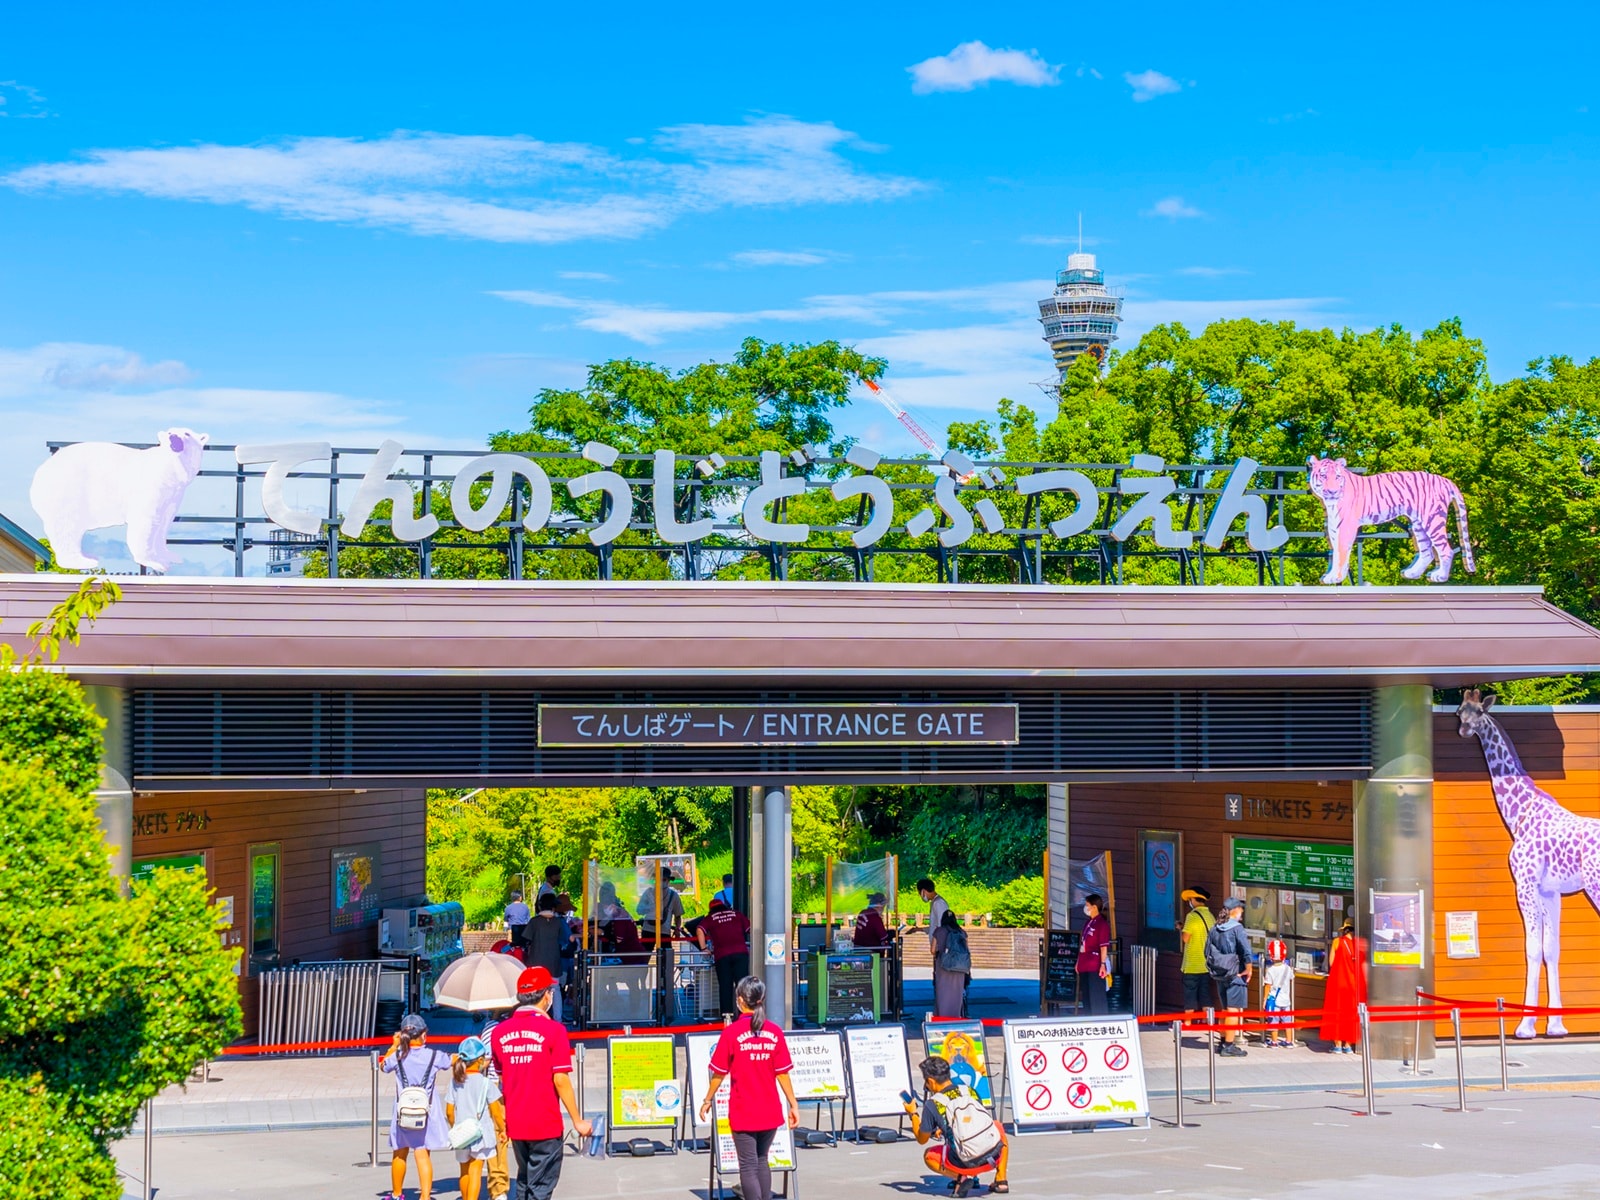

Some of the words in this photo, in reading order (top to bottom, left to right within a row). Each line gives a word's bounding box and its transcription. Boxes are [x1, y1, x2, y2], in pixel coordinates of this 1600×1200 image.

[235, 438, 1289, 552] てんのうじどうぶつえん
[572, 712, 735, 737] てんしばゲート
[763, 713, 906, 735] ENTRANCE
[917, 713, 984, 735] GATE
[1248, 798, 1312, 819] TICKETS
[1322, 801, 1354, 820] チケ
[499, 1031, 520, 1045] OSAKA
[1017, 1025, 1124, 1039] 園内へのお持込はできません
[513, 1044, 525, 1053] and
[526, 1043, 542, 1052] PARK
[510, 1055, 532, 1064] STAFF
